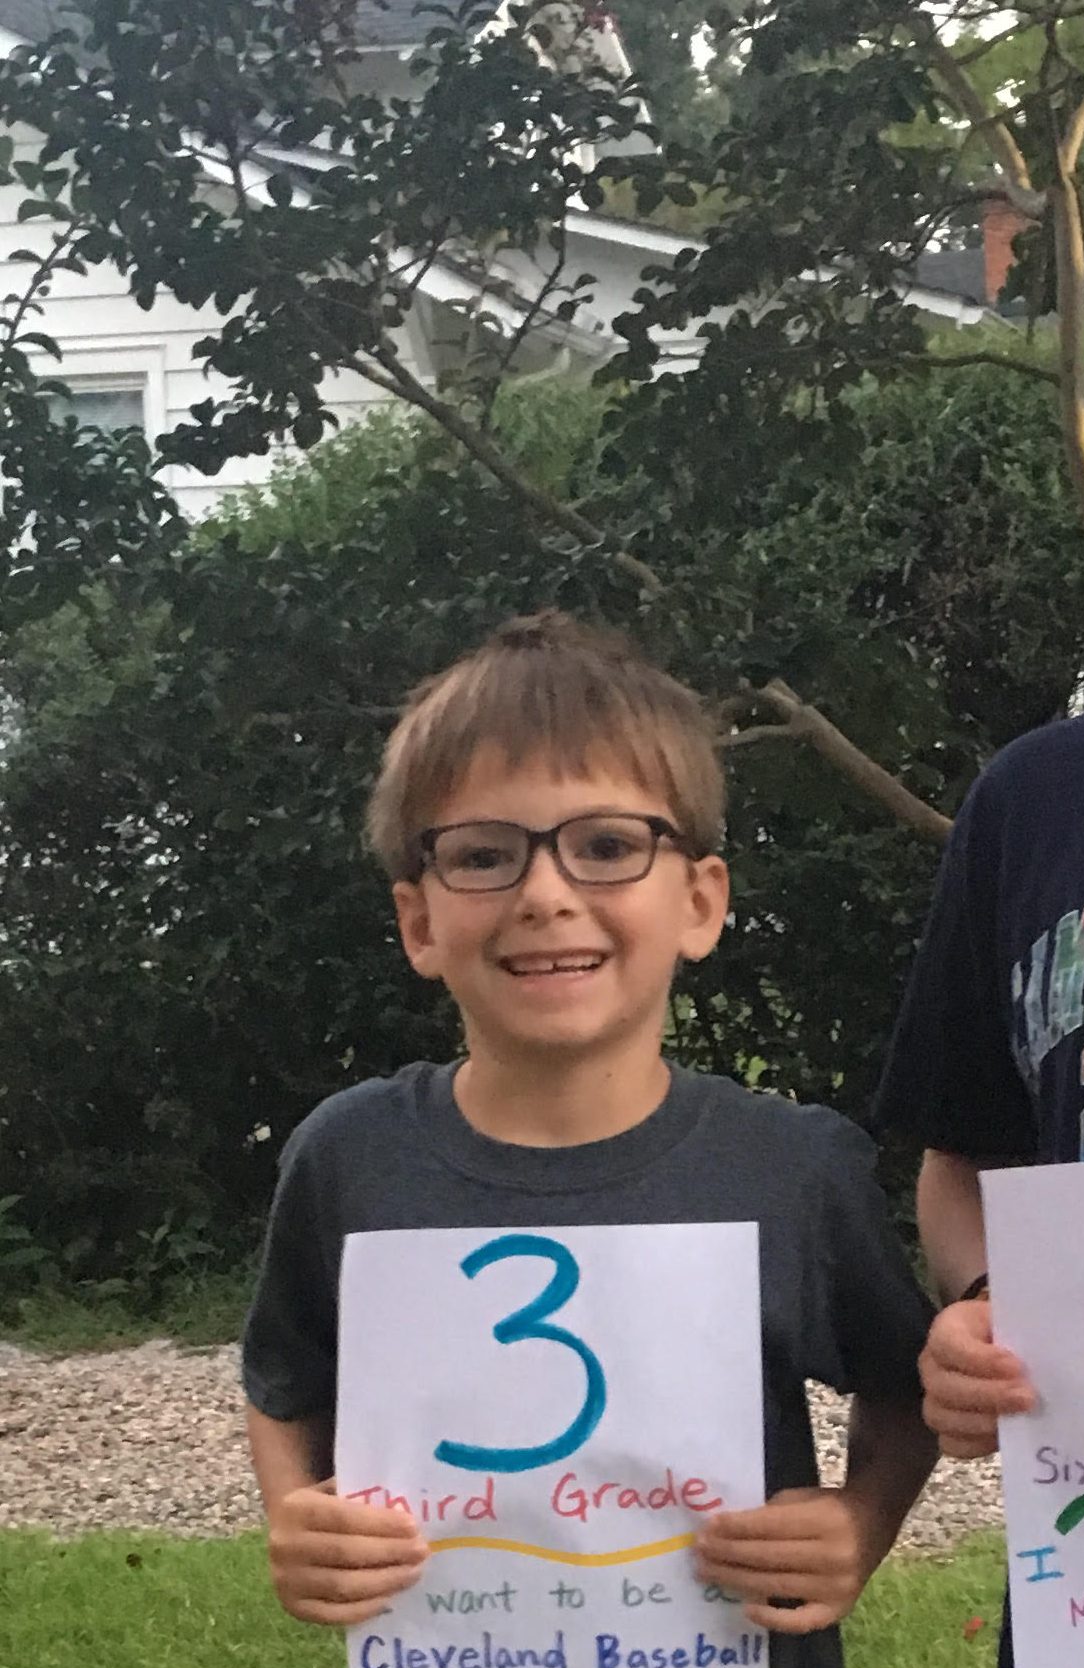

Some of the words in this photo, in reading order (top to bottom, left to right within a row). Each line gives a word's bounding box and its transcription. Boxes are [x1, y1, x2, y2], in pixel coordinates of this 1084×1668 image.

[433, 1233, 607, 1473] 3
[550, 1466, 723, 1522] Grade
[1016, 1545, 1065, 1583] I
[425, 1580, 519, 1615] want
[548, 1575, 585, 1609] to
[622, 1577, 673, 1608] be
[703, 1581, 742, 1605] a
